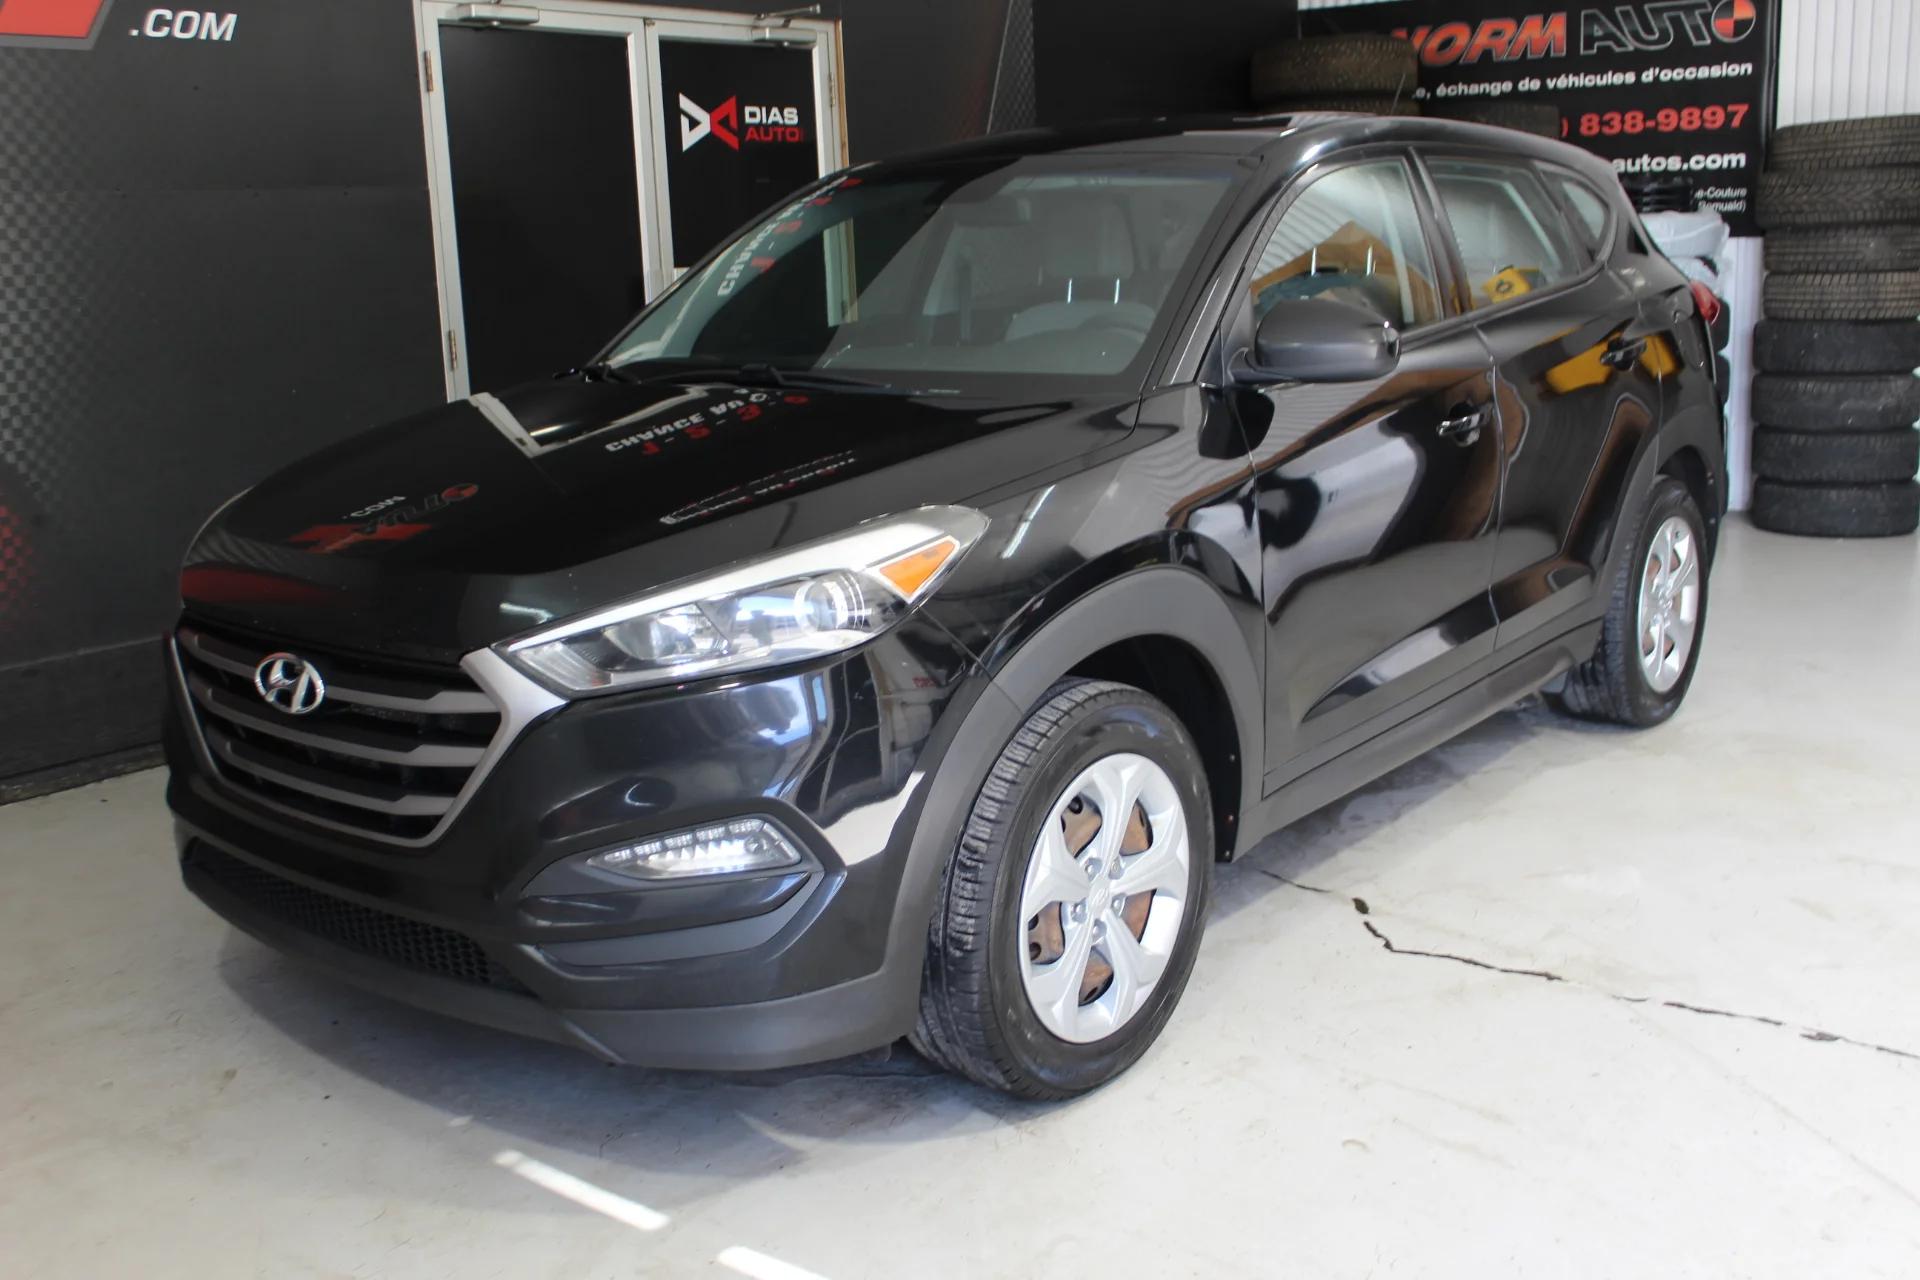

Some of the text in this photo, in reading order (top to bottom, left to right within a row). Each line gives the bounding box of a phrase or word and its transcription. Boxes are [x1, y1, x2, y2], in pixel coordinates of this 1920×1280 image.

[129, 8, 237, 41] .COM
[1436, 80, 1513, 97] échange
[1518, 76, 1542, 92] de
[1546, 70, 1636, 90] véhicules
[1641, 61, 1752, 82] d'occasion
[744, 105, 799, 125] DIAS
[1579, 103, 1749, 137] 838-9897
[744, 126, 800, 142] AUTO
